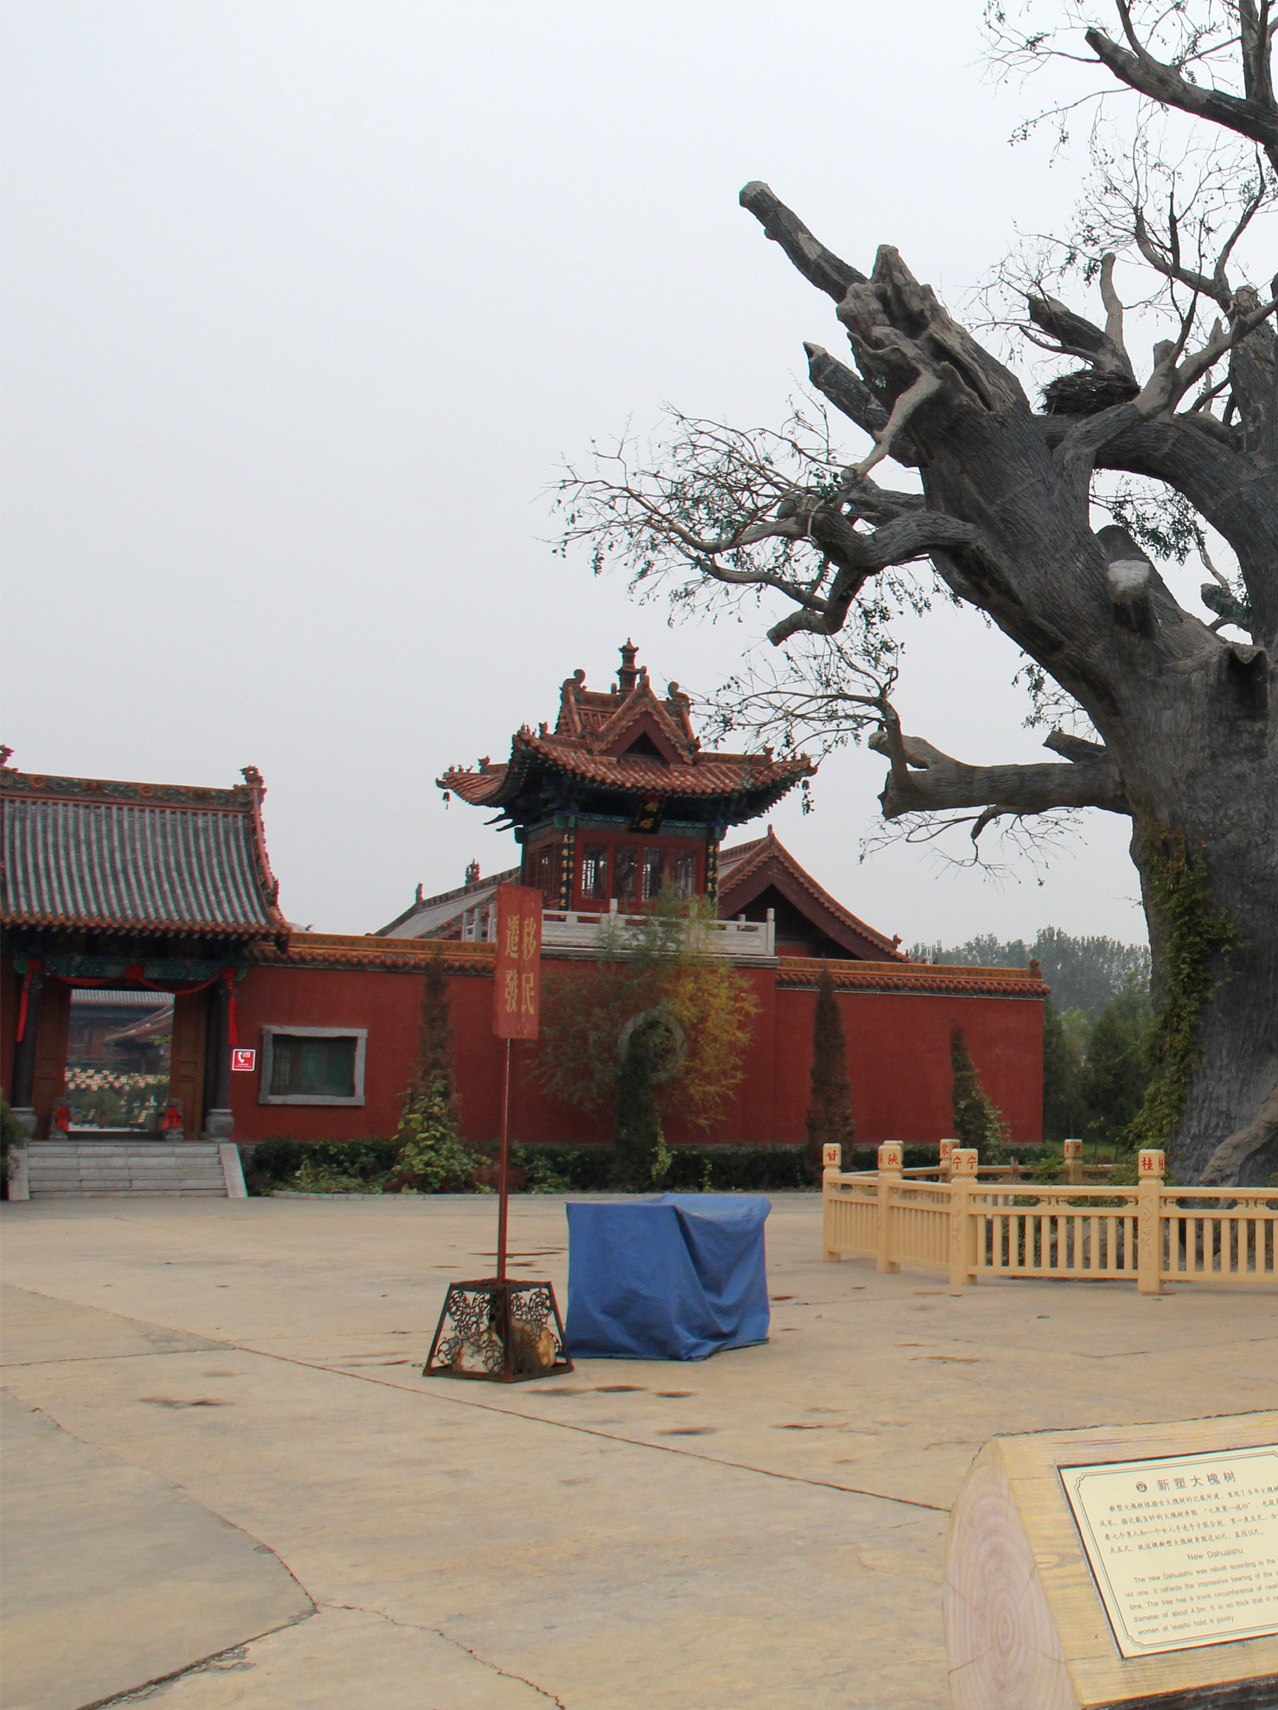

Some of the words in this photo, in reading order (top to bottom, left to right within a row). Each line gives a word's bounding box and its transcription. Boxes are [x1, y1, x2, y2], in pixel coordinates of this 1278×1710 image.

[522, 916, 537, 1016] 移民
[826, 1149, 838, 1161] 甘
[952, 1155, 962, 1170] 宁
[966, 1155, 977, 1170] 宁
[1141, 1156, 1154, 1171] 桂
[1156, 1470, 1236, 1492] 新塑大槐树
[1186, 1553, 1204, 1561] New
[1206, 1547, 1244, 1559] Dahuaishu
[1132, 1576, 1147, 1584] The
[1162, 1570, 1194, 1580] Dahuaishu
[1209, 1564, 1228, 1573] rebuilt
[1229, 1561, 1257, 1570] according
[1160, 1584, 1183, 1593] reflects
[1196, 1578, 1229, 1588] impressive
[1230, 1574, 1253, 1583] bearing
[1146, 1600, 1160, 1608] The
[1196, 1592, 1212, 1601] trunk
[1214, 1587, 1254, 1598] circumference
[1256, 1584, 1263, 1592] of
[1133, 1613, 1160, 1623] diameter
[1171, 1608, 1189, 1617] about
[1235, 1599, 1250, 1607] thick
[1251, 1596, 1264, 1605] that
[1137, 1627, 1160, 1635] women
[1193, 1618, 1208, 1627] hold
